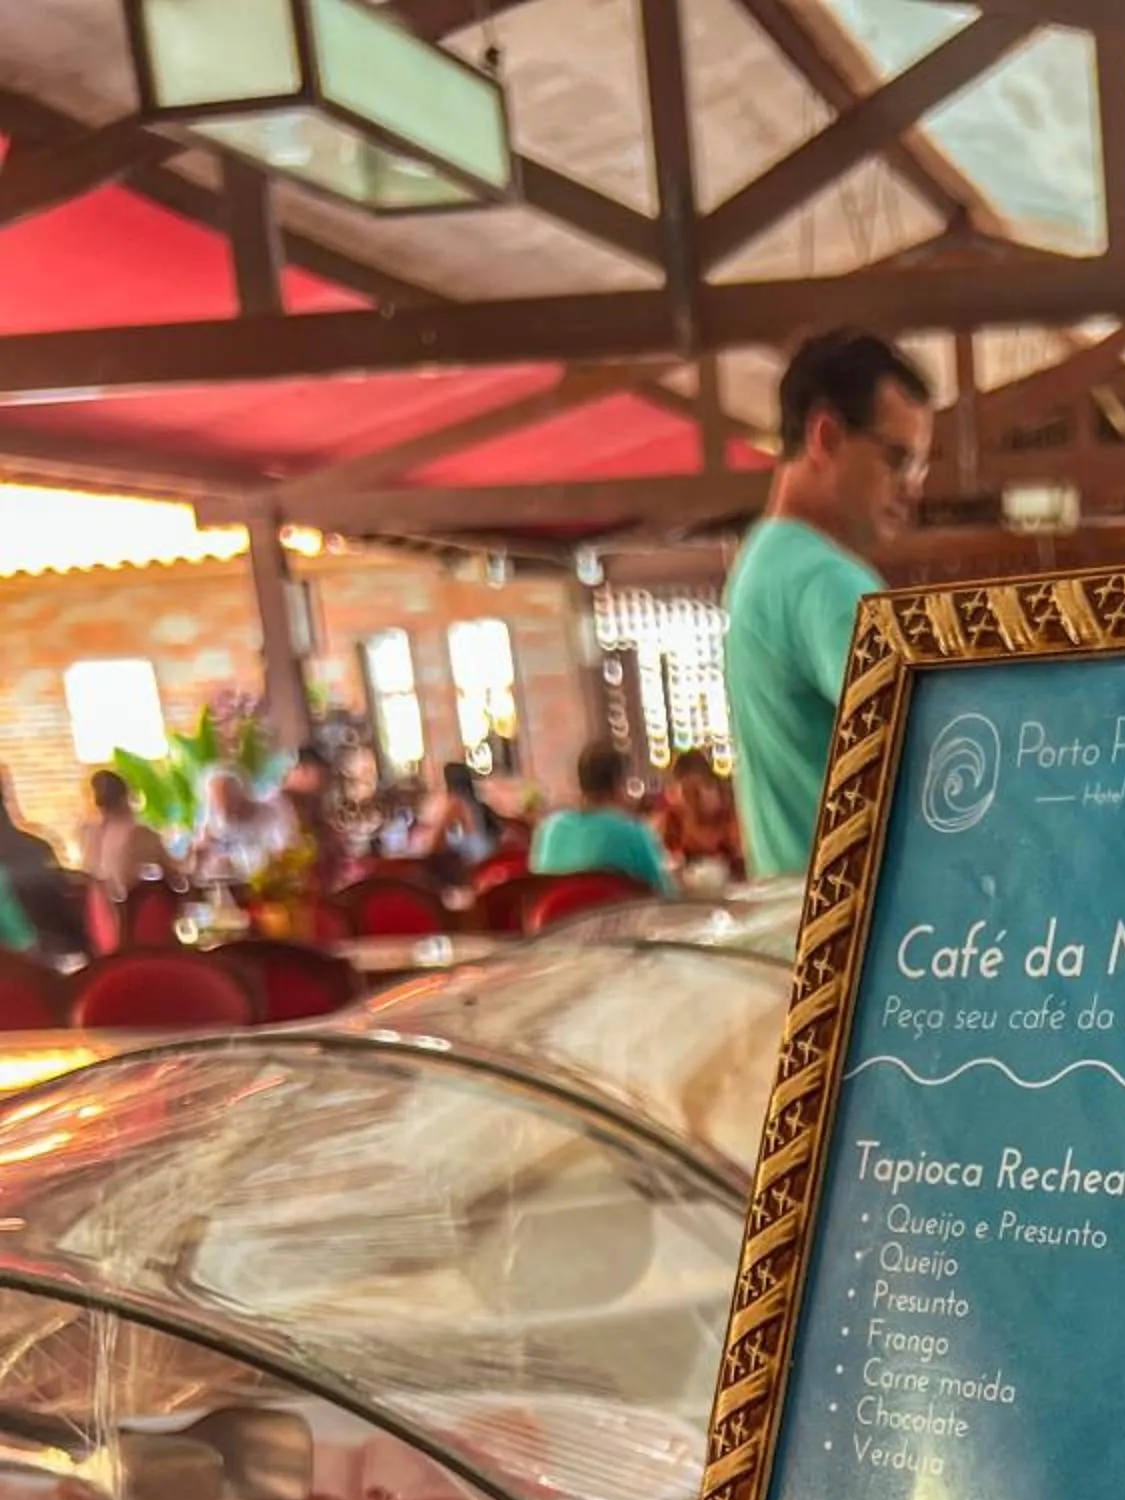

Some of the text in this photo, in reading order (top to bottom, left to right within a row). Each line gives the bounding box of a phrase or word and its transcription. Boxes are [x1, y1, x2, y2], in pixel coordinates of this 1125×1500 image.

[1016, 721, 1100, 769] Porto
[898, 920, 1005, 978] Café
[1024, 917, 1084, 977] da
[882, 994, 943, 1039] Peça
[954, 1005, 997, 1029] seu
[1009, 993, 1066, 1030] café
[1077, 994, 1113, 1030] da
[856, 1140, 983, 1194] Tapioca
[887, 1203, 1107, 1249] Queijo e Presunto
[880, 1242, 958, 1280] Queijo
[873, 1280, 970, 1317] Presunto
[867, 1318, 949, 1362] Frango
[863, 1357, 930, 1393] Carne
[856, 1395, 970, 1438] Chocolate
[853, 1434, 945, 1475] Verdura
